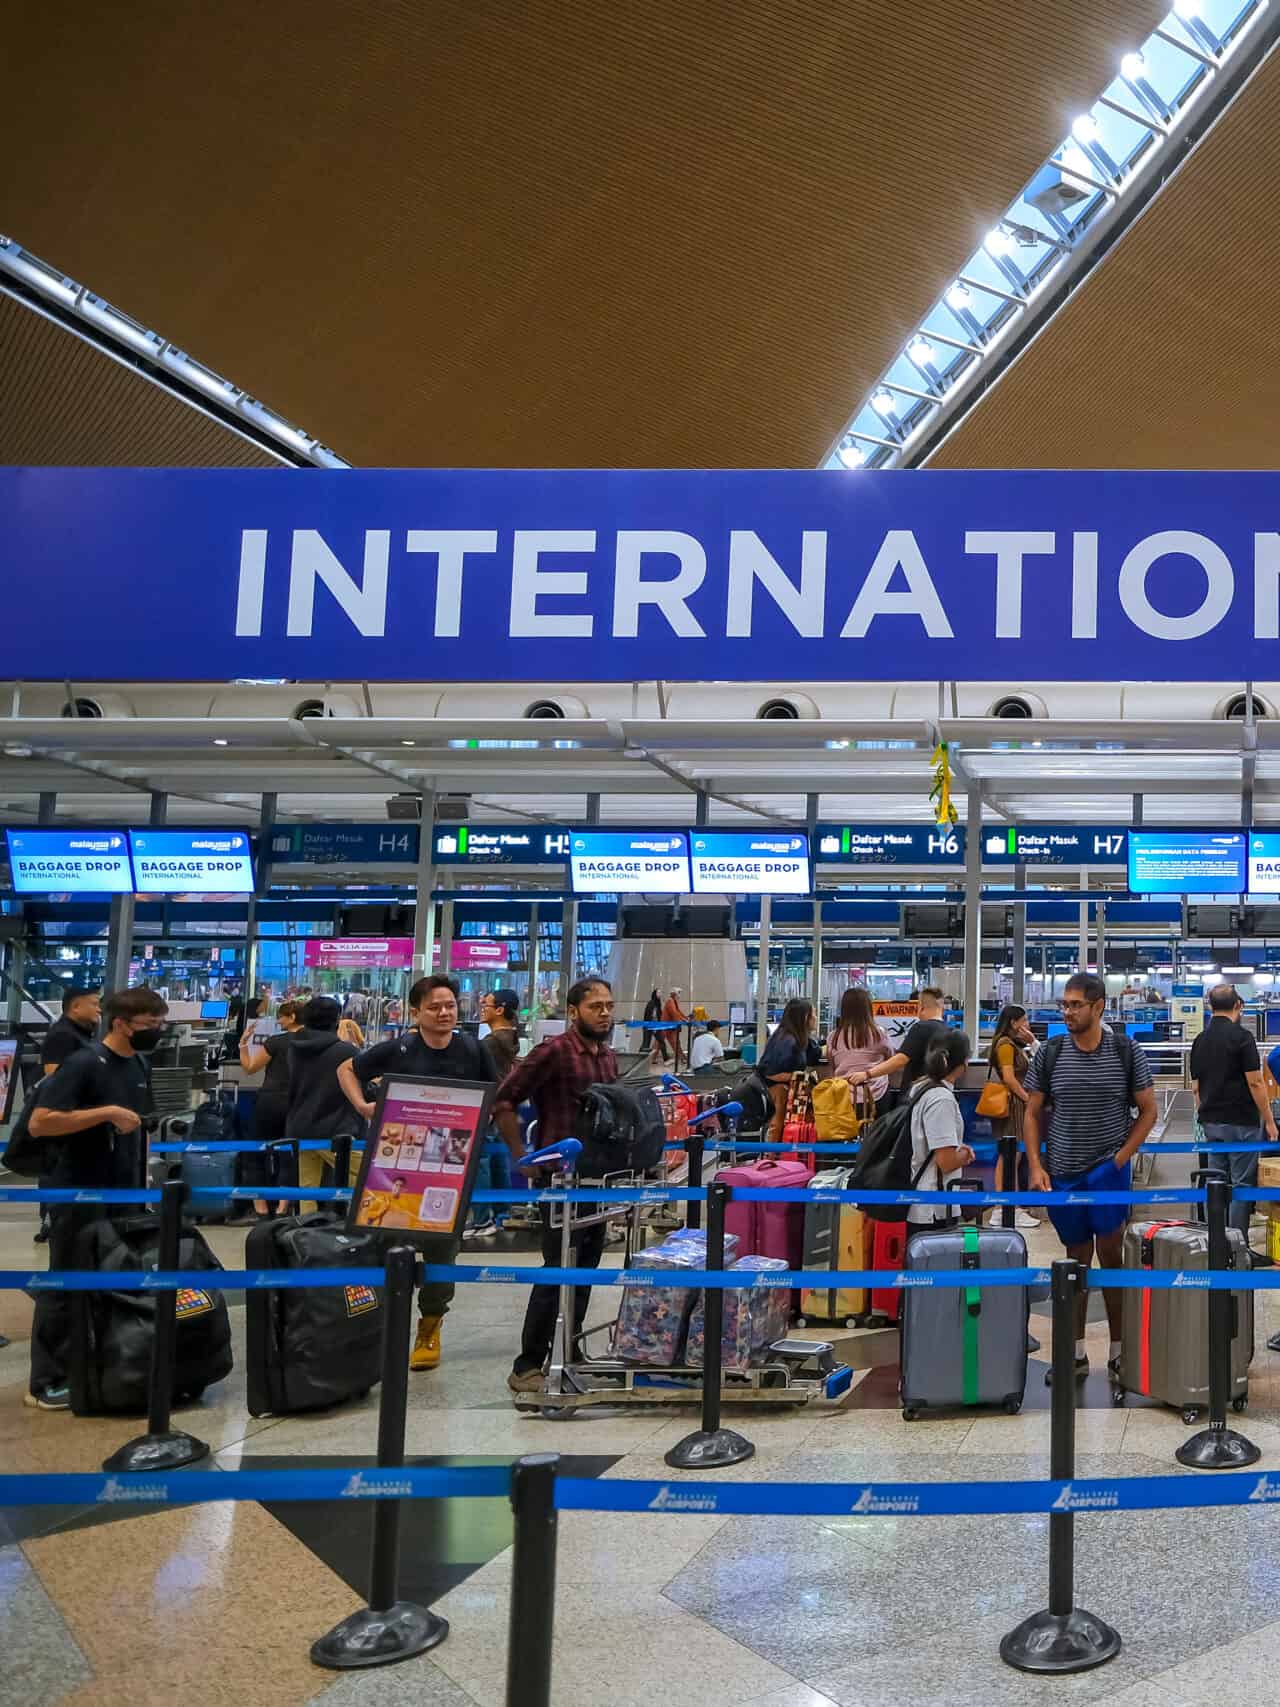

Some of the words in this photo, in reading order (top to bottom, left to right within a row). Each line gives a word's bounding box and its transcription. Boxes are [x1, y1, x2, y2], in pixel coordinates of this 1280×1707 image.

[379, 834, 409, 851] H4
[468, 835, 498, 845] Daftar
[500, 835, 530, 845] Masuk
[852, 835, 882, 844] Daftar
[884, 835, 912, 844] Masuk
[1018, 835, 1048, 845] Daftar
[1050, 835, 1078, 845] Masuk
[928, 835, 959, 854] H6
[1094, 835, 1124, 854] H7
[19, 862, 82, 871] BAGGAGE
[86, 862, 121, 871] DROP
[141, 862, 204, 871] BAGGAGE
[207, 862, 242, 871] DROP
[579, 863, 641, 872] BAGGAGE
[645, 863, 680, 872] DROP
[699, 863, 761, 872] BAGGAGE
[765, 863, 800, 872] DROP
[115, 1490, 168, 1499] AIRPORTS
[359, 1486, 412, 1495] AIRPORTS
[666, 1500, 717, 1509] AIRPORTS
[868, 1501, 919, 1511] AIRPORTS
[1069, 1496, 1118, 1507] AIRPORTS
